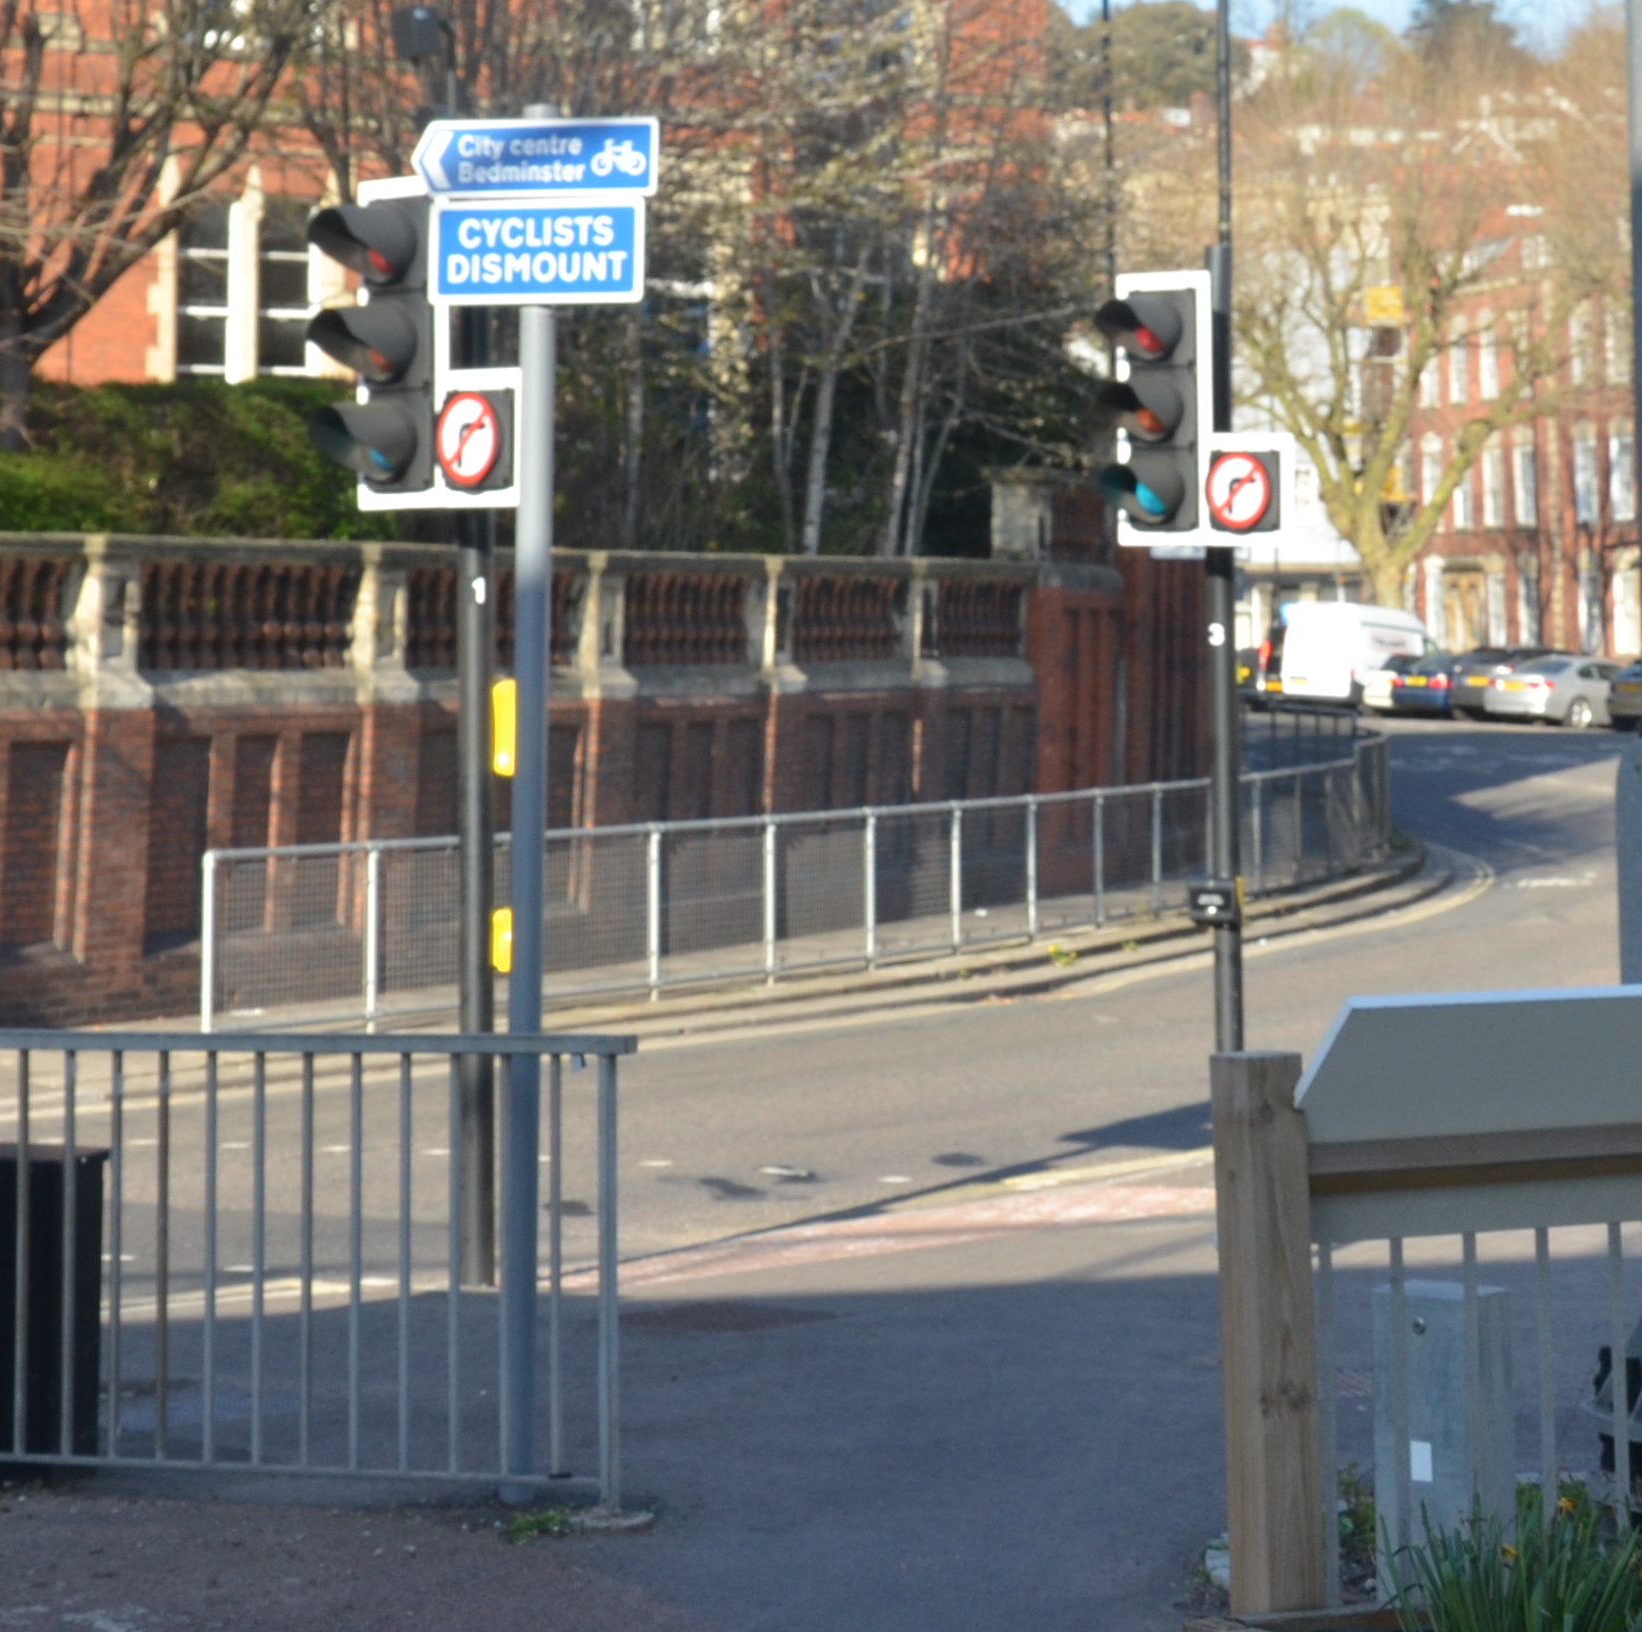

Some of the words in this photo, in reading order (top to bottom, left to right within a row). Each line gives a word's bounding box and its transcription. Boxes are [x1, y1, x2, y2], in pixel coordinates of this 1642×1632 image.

[458, 134, 504, 160] City
[509, 135, 583, 157] centre
[458, 160, 586, 184] Bedminster
[458, 215, 614, 249] CYCLISTS
[447, 251, 627, 284] DISMOUNT
[471, 576, 486, 604] 1
[1207, 622, 1226, 647] 3
